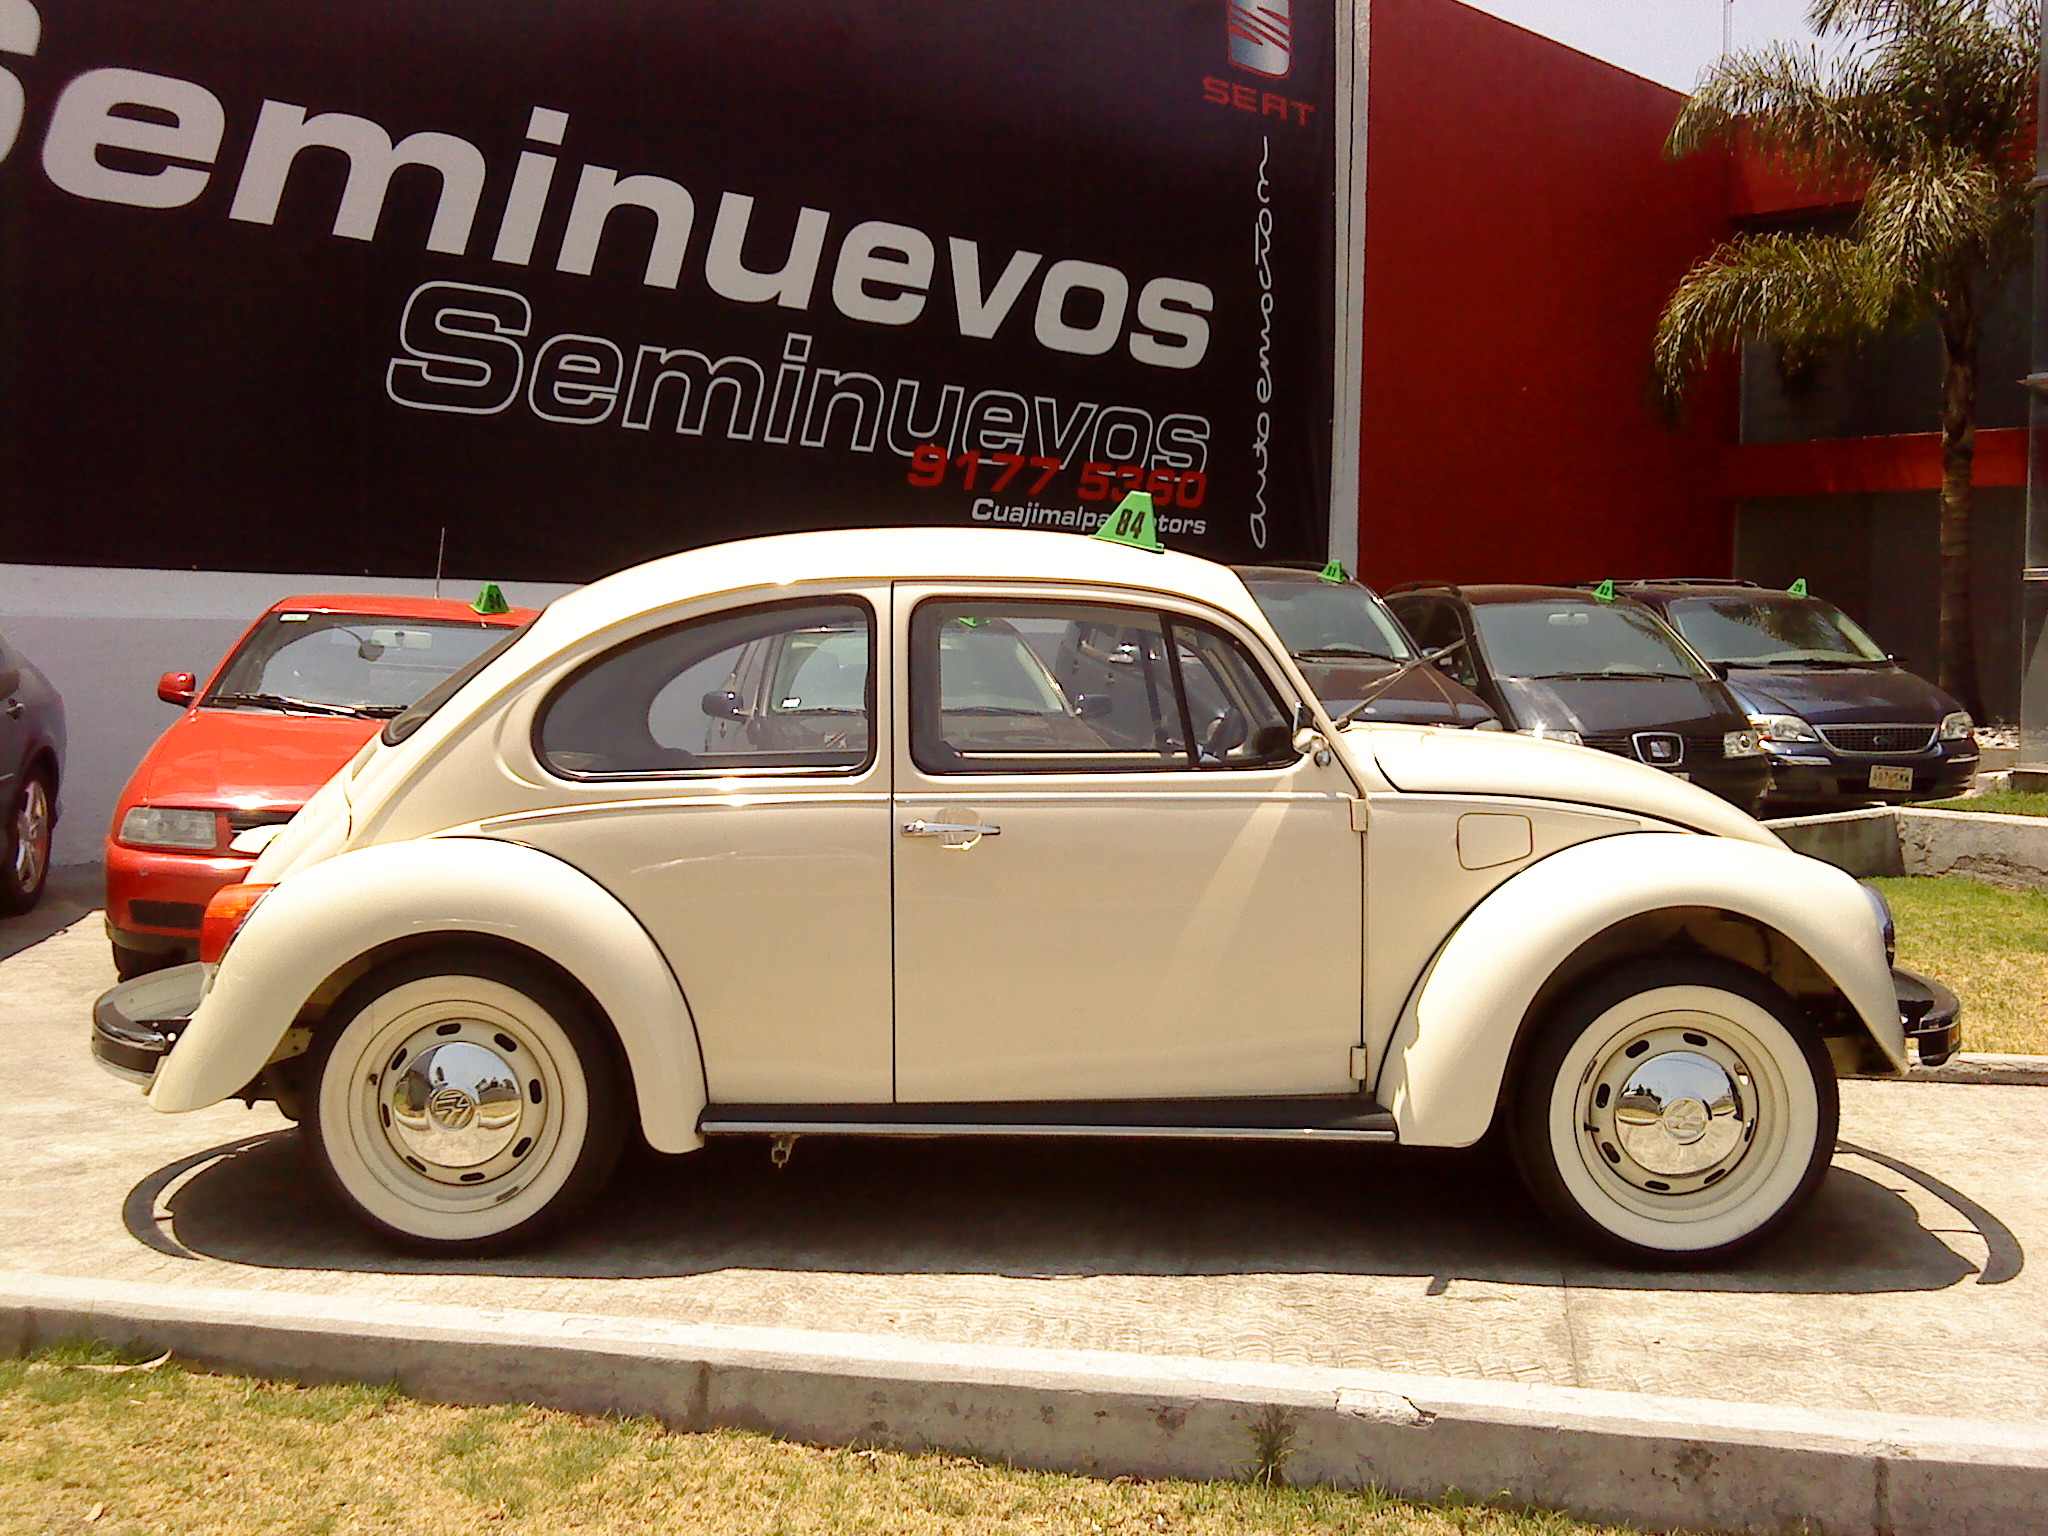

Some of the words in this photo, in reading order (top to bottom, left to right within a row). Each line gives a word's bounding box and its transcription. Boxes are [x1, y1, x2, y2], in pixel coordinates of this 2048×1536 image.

[1202, 76, 1316, 127] SEAT
[386, 280, 1211, 483] Seminuevos
[907, 444, 1062, 495] 9177
[1077, 461, 1208, 509] 5360
[1250, 411, 1270, 549] auto
[1115, 508, 1146, 539] 84
[1154, 514, 1207, 535] tors
